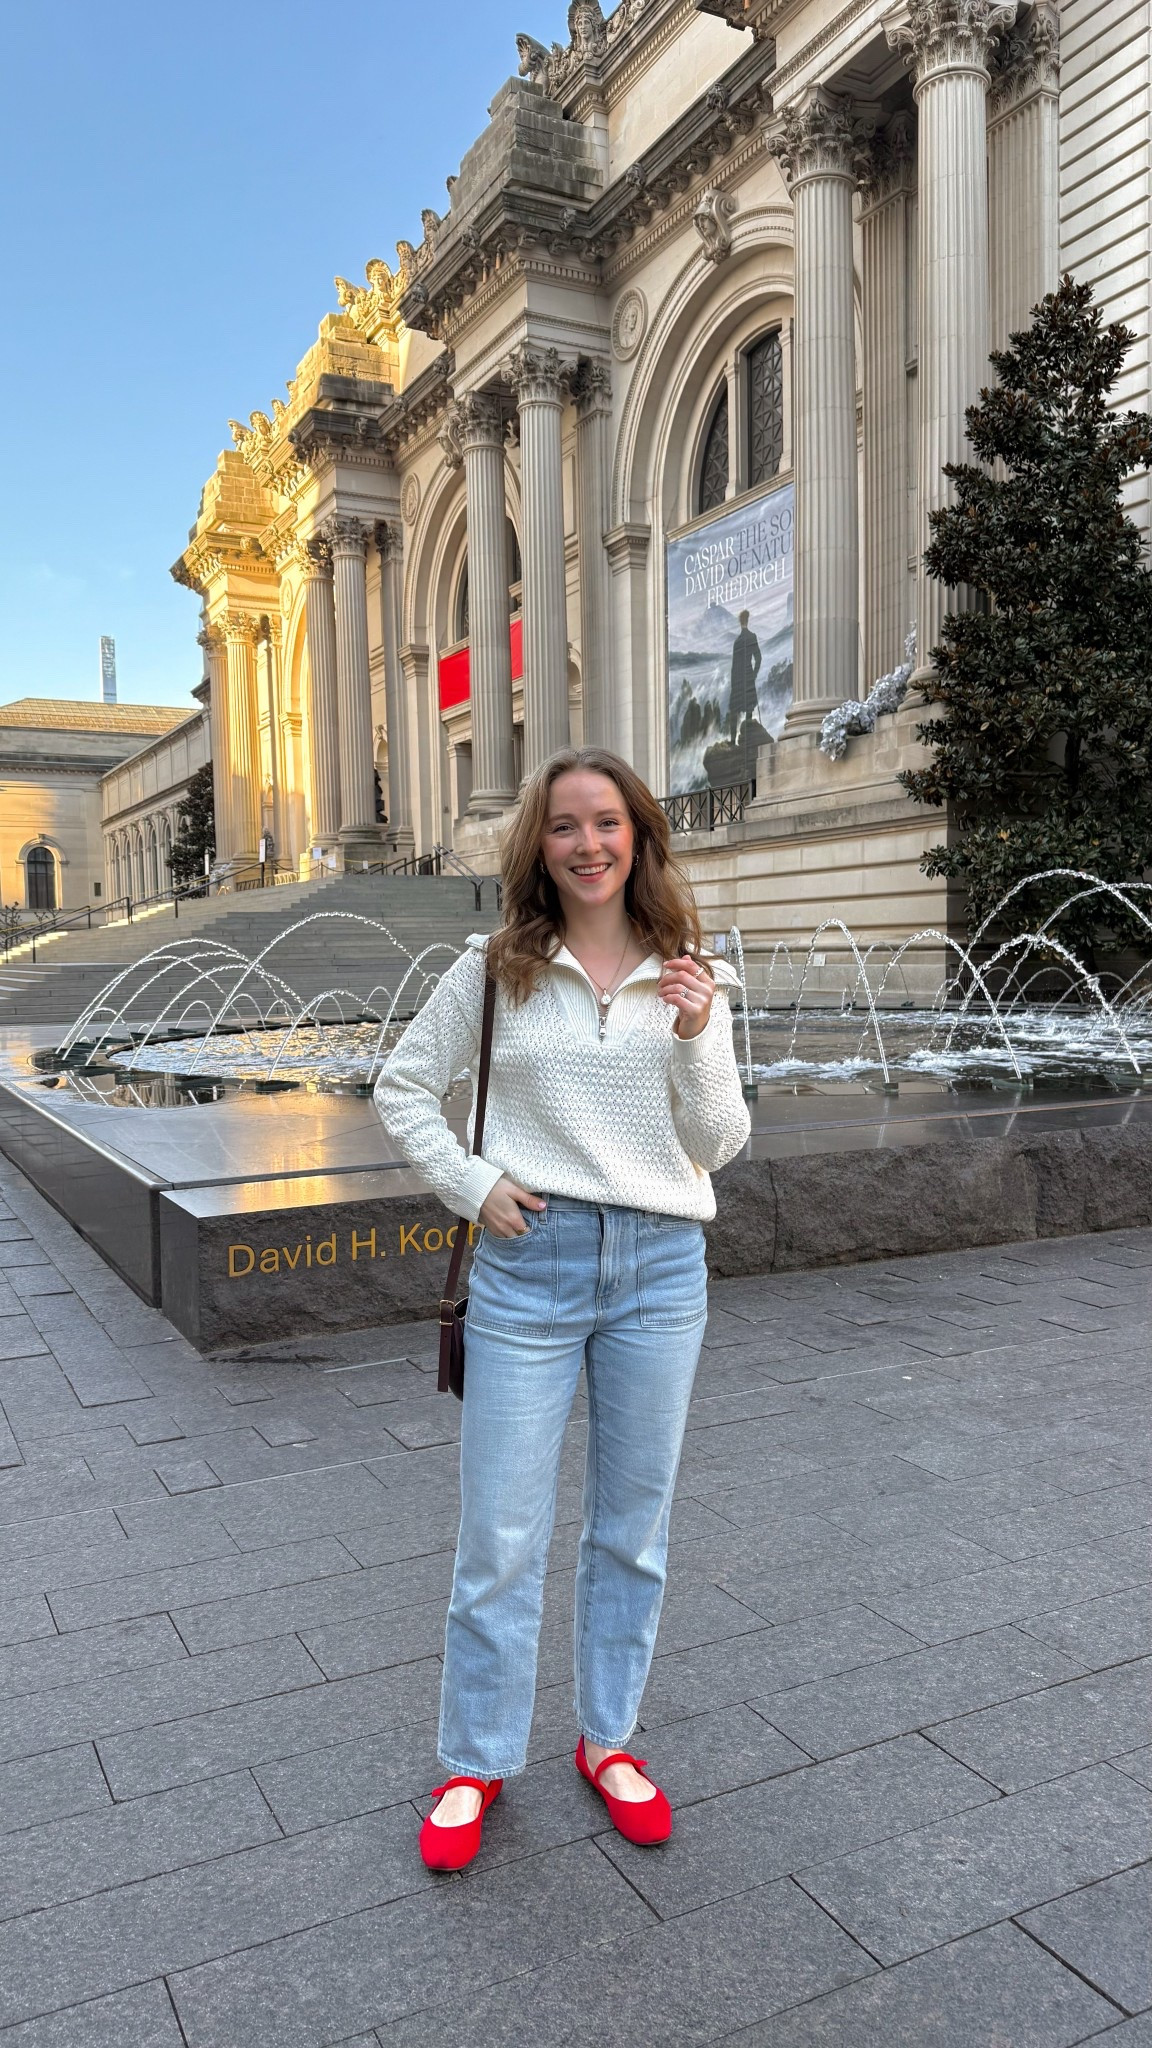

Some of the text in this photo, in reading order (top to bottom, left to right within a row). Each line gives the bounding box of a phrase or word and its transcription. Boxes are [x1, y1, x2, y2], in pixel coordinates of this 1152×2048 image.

[684, 506, 794, 575] CASPAR THE SO
[685, 530, 794, 597] DAVID OF NATU
[707, 557, 785, 610] FRIEDRICH
[228, 1233, 337, 1278] David
[351, 1227, 386, 1261] H.
